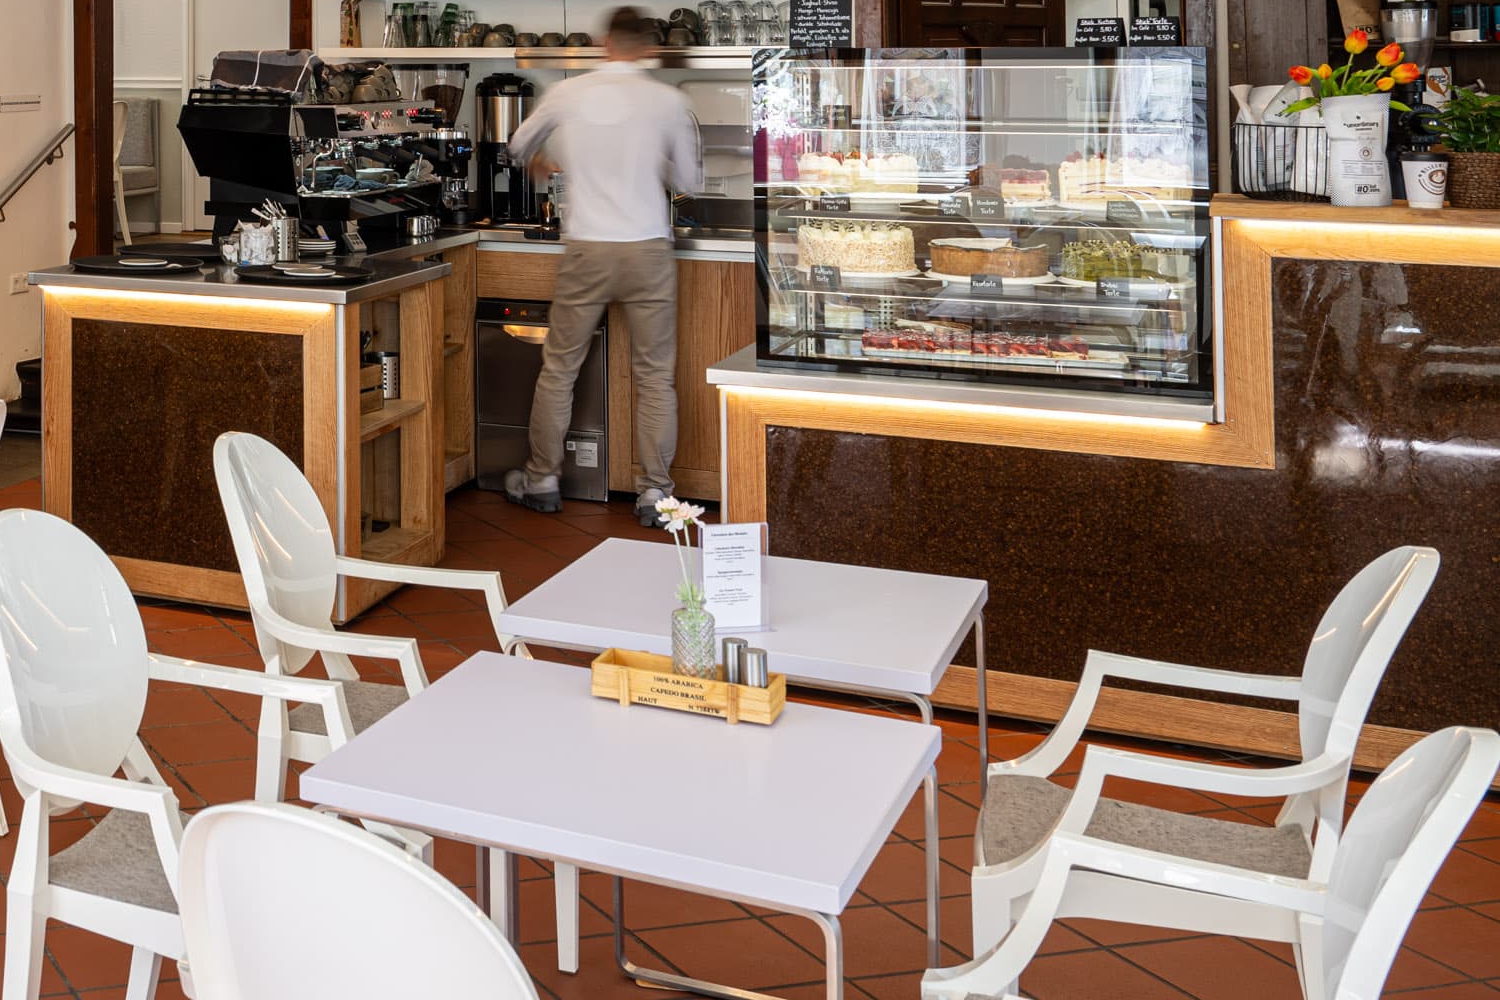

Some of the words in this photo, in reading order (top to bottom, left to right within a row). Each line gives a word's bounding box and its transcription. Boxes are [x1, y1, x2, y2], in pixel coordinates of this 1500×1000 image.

[1356, 185, 1369, 193] #0
[1102, 289, 1120, 297] Torte
[671, 679, 704, 690] ARABICA
[680, 691, 707, 701] BRASIL
